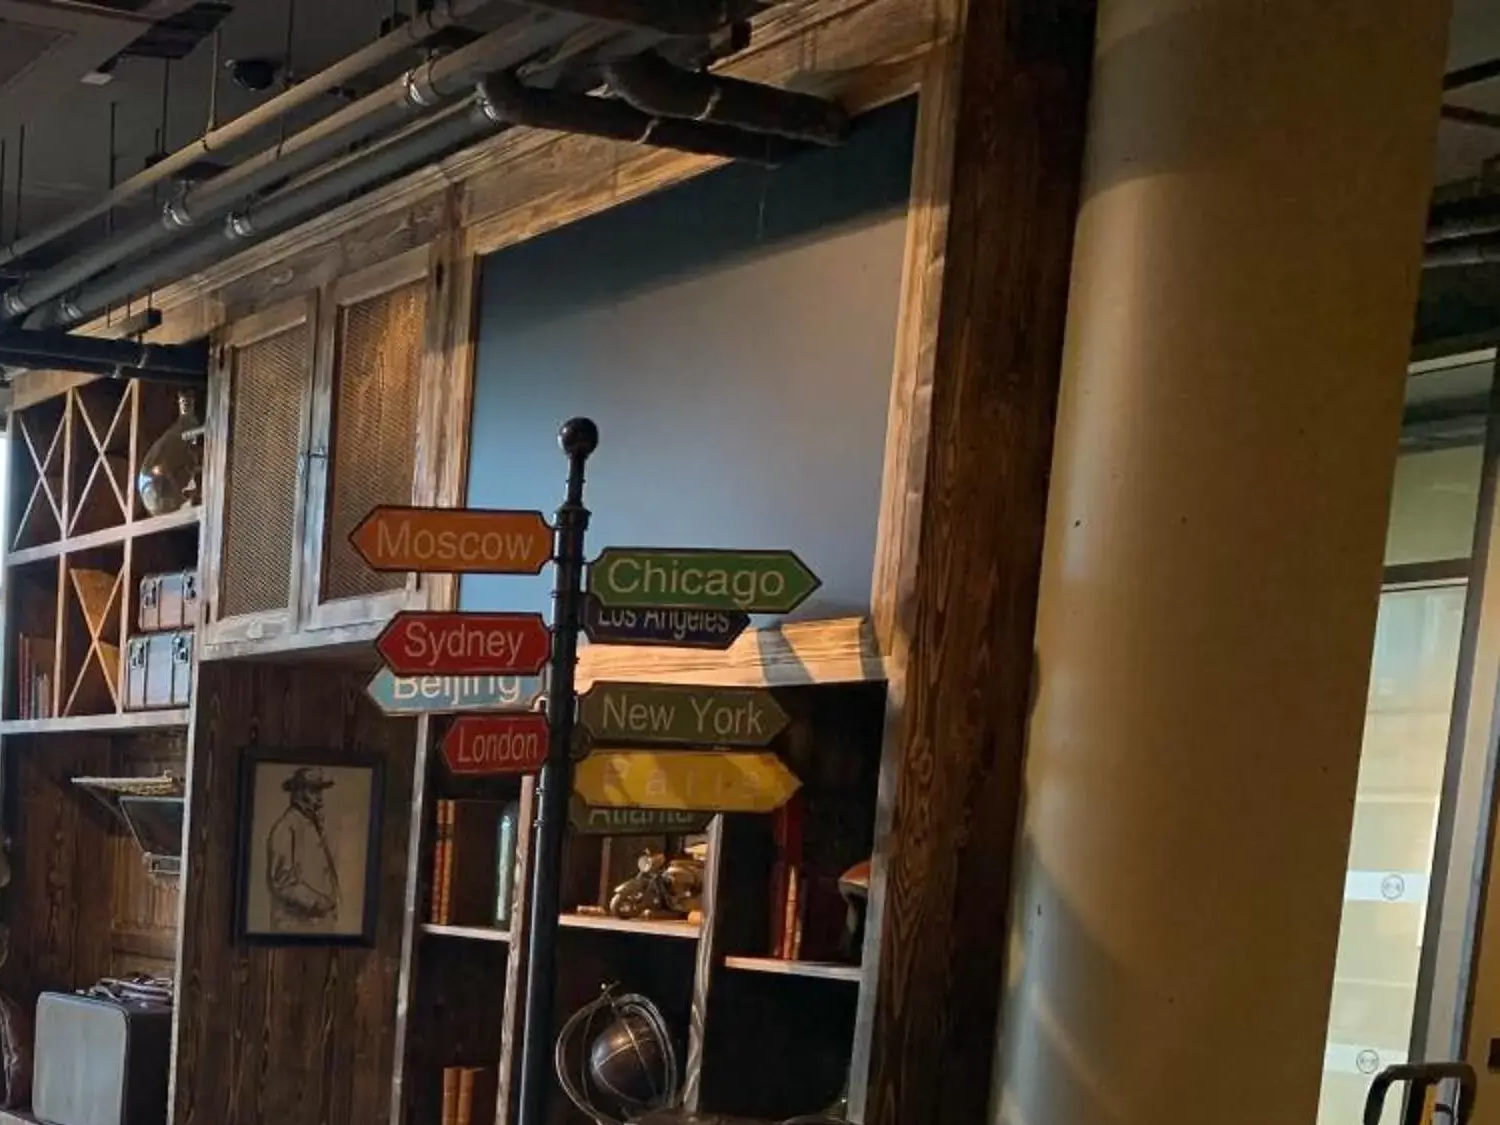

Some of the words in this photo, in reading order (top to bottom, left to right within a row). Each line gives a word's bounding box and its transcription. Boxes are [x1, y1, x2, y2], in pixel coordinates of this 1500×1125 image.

[376, 518, 535, 561] Moscow
[607, 557, 785, 606] Chicago
[404, 621, 525, 666] Sydney
[598, 609, 636, 628] Los
[643, 610, 730, 640] Angeles
[393, 675, 521, 704] Beijing
[601, 695, 675, 731] New
[690, 697, 764, 736] York
[457, 726, 538, 763] London
